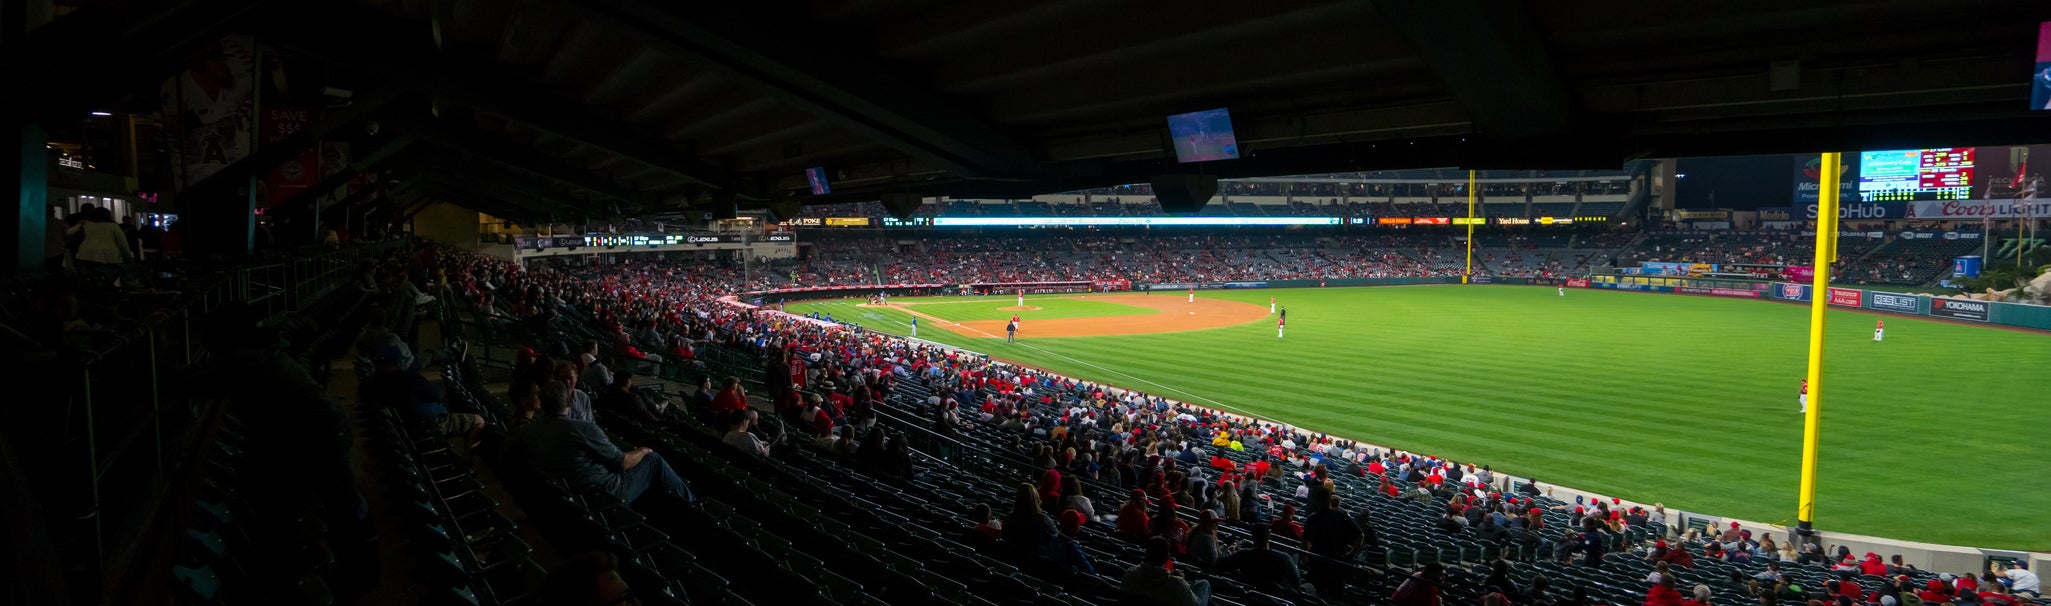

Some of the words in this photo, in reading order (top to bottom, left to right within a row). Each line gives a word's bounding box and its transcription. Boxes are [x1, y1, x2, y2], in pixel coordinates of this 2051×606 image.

[272, 109, 309, 122] SAVE
[1942, 200, 1997, 217] Coors
[1999, 203, 2051, 215] LIGHT
[1760, 209, 1790, 220] Modelo
[803, 217, 821, 226] POKE
[1499, 217, 1512, 225] Yard
[1513, 217, 1530, 225] House
[1834, 289, 1858, 298] Insurance
[1834, 297, 1858, 305] AAA.com
[1874, 294, 1893, 305] RES
[1894, 297, 1916, 308] LIST
[1944, 300, 1986, 312] YOKOHAMA
